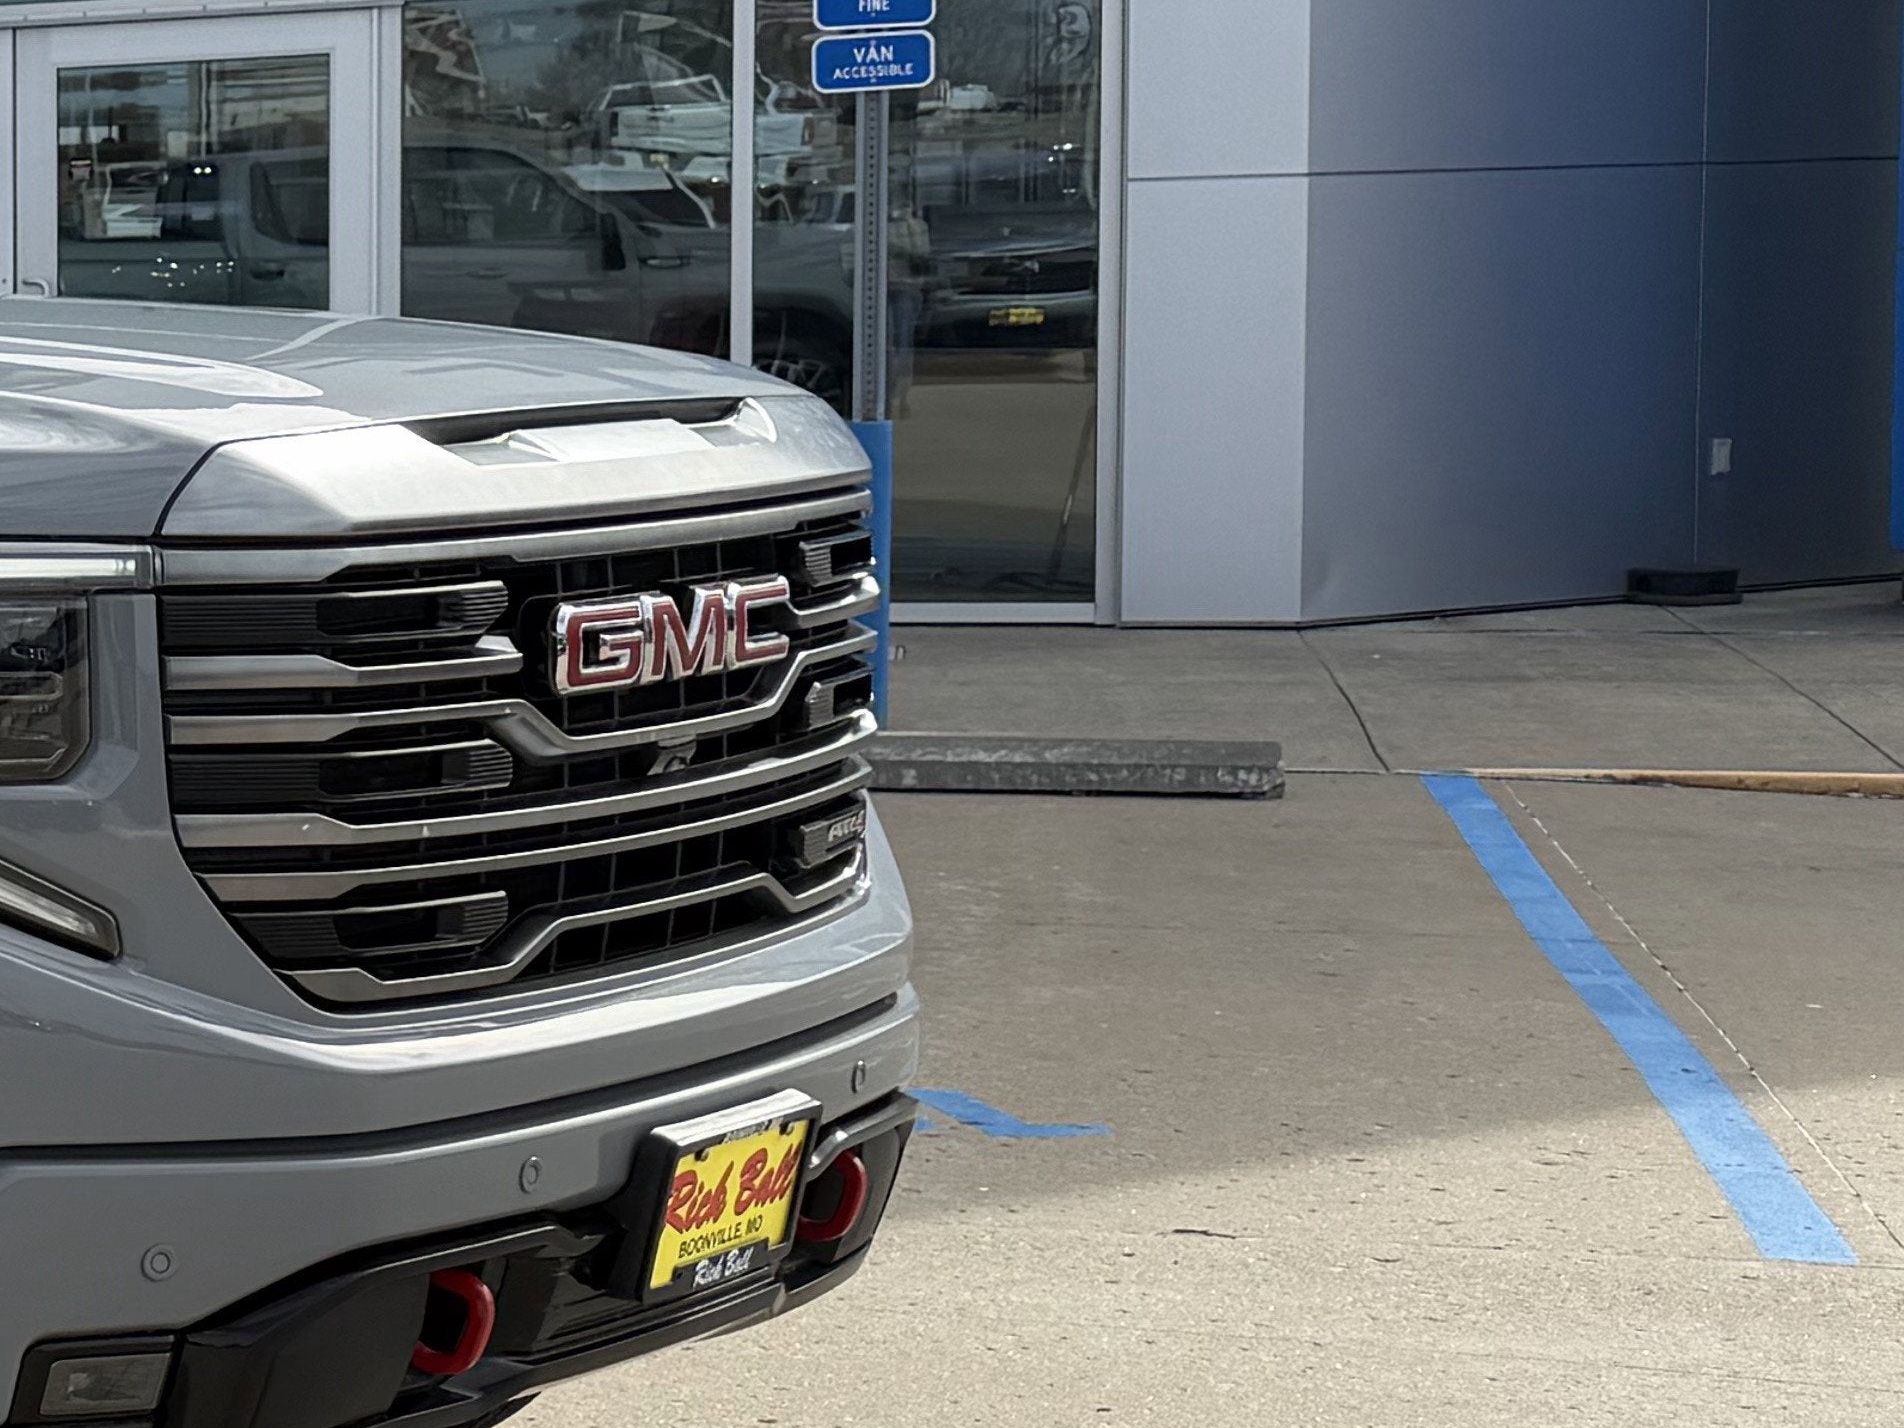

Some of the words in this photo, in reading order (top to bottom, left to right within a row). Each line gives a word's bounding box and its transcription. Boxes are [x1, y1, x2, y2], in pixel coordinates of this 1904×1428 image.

[833, 63, 913, 80] ACCESSIBLE
[853, 45, 894, 63] VAN
[556, 574, 791, 694] GMC
[666, 1161, 734, 1234] Rick
[734, 1139, 802, 1216] Ball
[678, 1222, 742, 1259] BOONVILLE
[745, 1214, 763, 1235] MO
